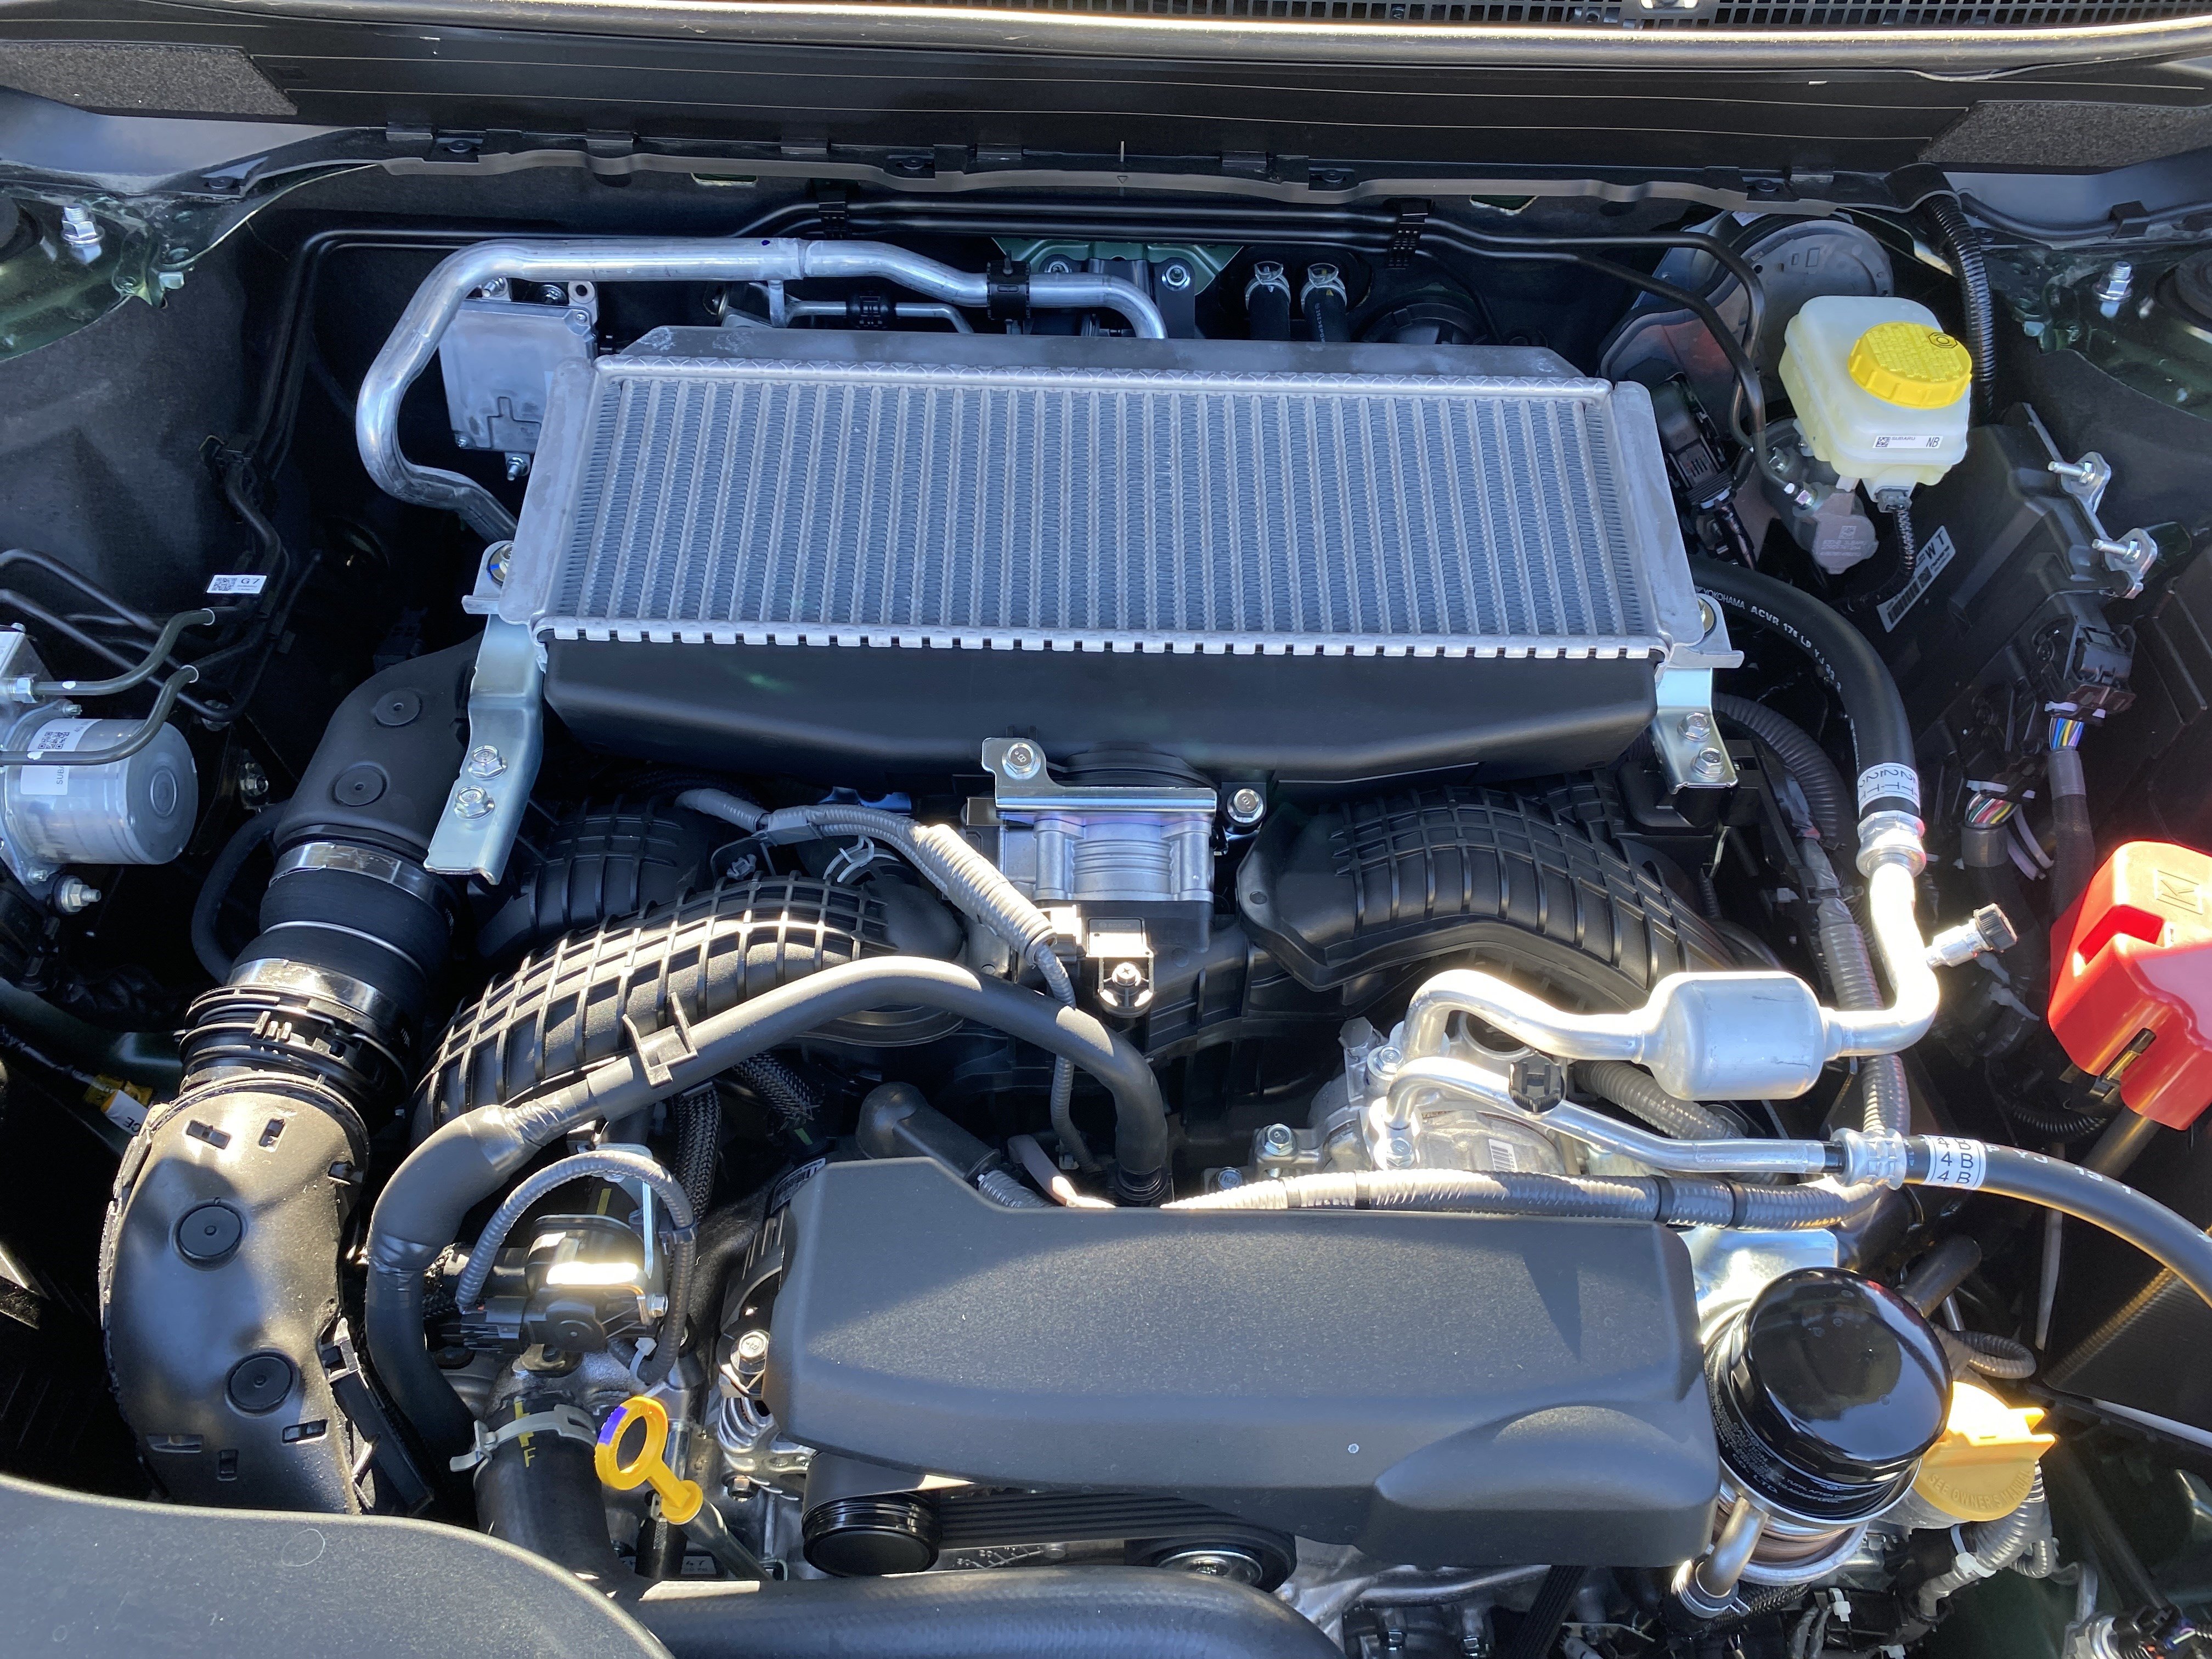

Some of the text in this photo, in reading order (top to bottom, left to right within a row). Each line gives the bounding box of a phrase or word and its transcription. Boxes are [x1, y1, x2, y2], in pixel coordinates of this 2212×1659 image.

[1926, 437, 1940, 448] NB
[1703, 588, 1746, 610] YOKOHAMA
[1750, 606, 1779, 626] ACVR
[1522, 1062, 1551, 1096] H
[2074, 1166, 2103, 1182] 13
[523, 1446, 537, 1468] F
[1928, 1469, 2031, 1509] SEE OWNER'S MANUAL
